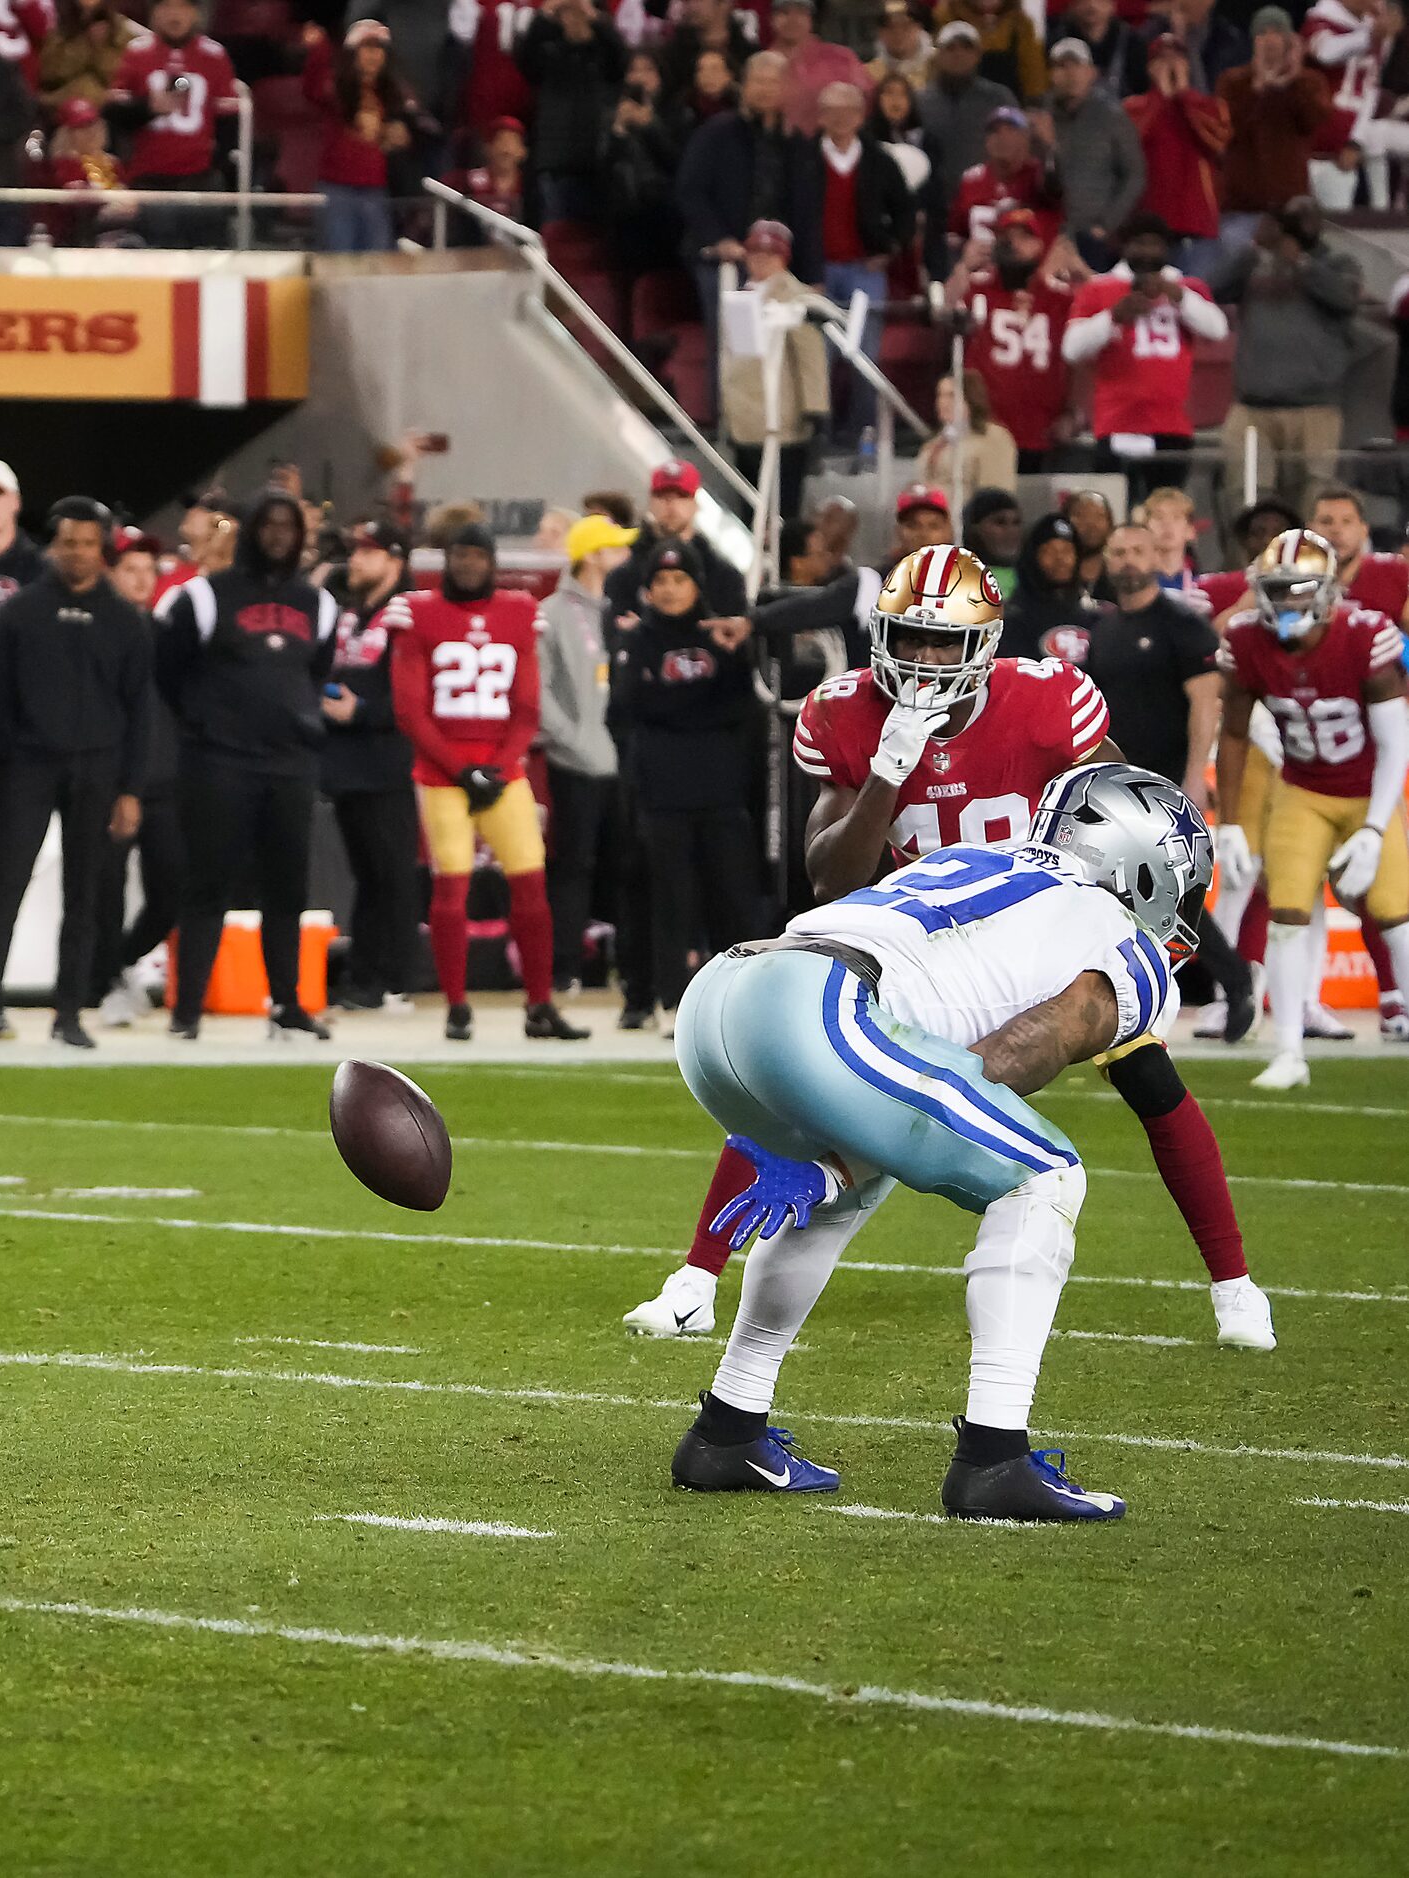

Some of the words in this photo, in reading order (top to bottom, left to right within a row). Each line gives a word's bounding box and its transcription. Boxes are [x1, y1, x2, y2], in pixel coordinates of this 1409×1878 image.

[990, 307, 1052, 370] 54
[431, 640, 519, 721] 22
[926, 781, 968, 800] 49ERS
[832, 846, 1064, 935] 21
